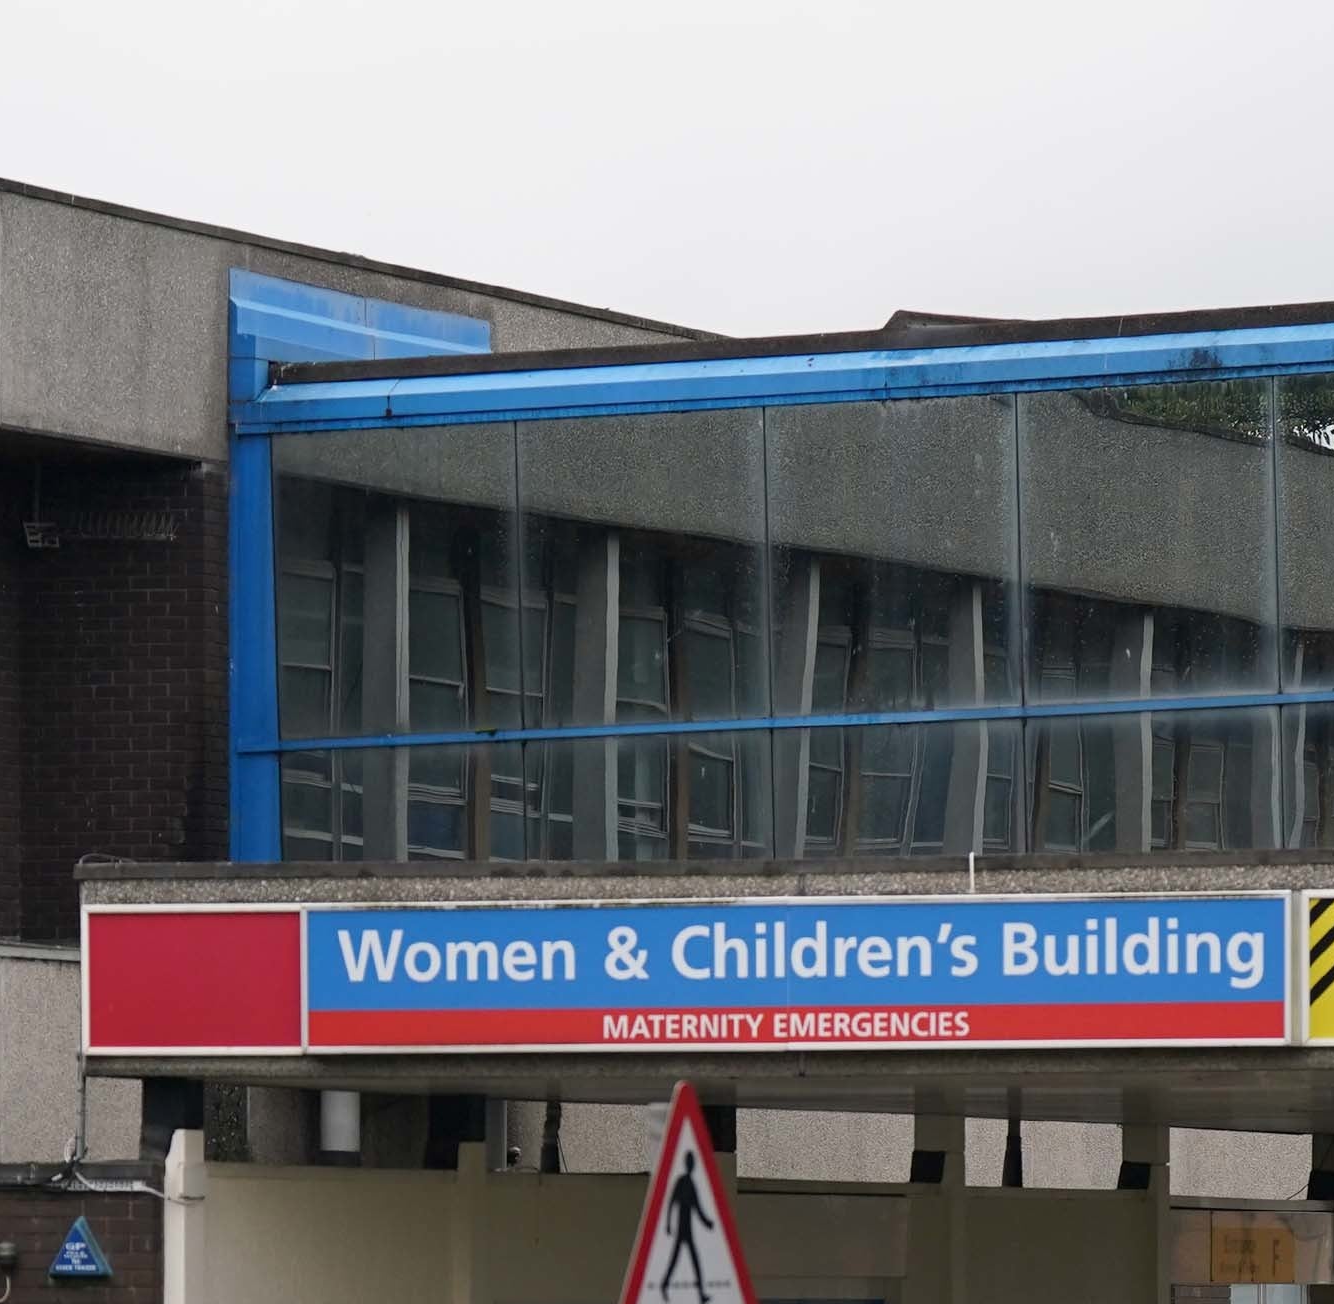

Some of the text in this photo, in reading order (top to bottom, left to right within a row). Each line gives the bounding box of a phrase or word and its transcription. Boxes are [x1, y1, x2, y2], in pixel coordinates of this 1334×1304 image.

[337, 918, 1265, 988] Women & Children's Building
[603, 1011, 970, 1040] MATERNITY EMERGENCIES
